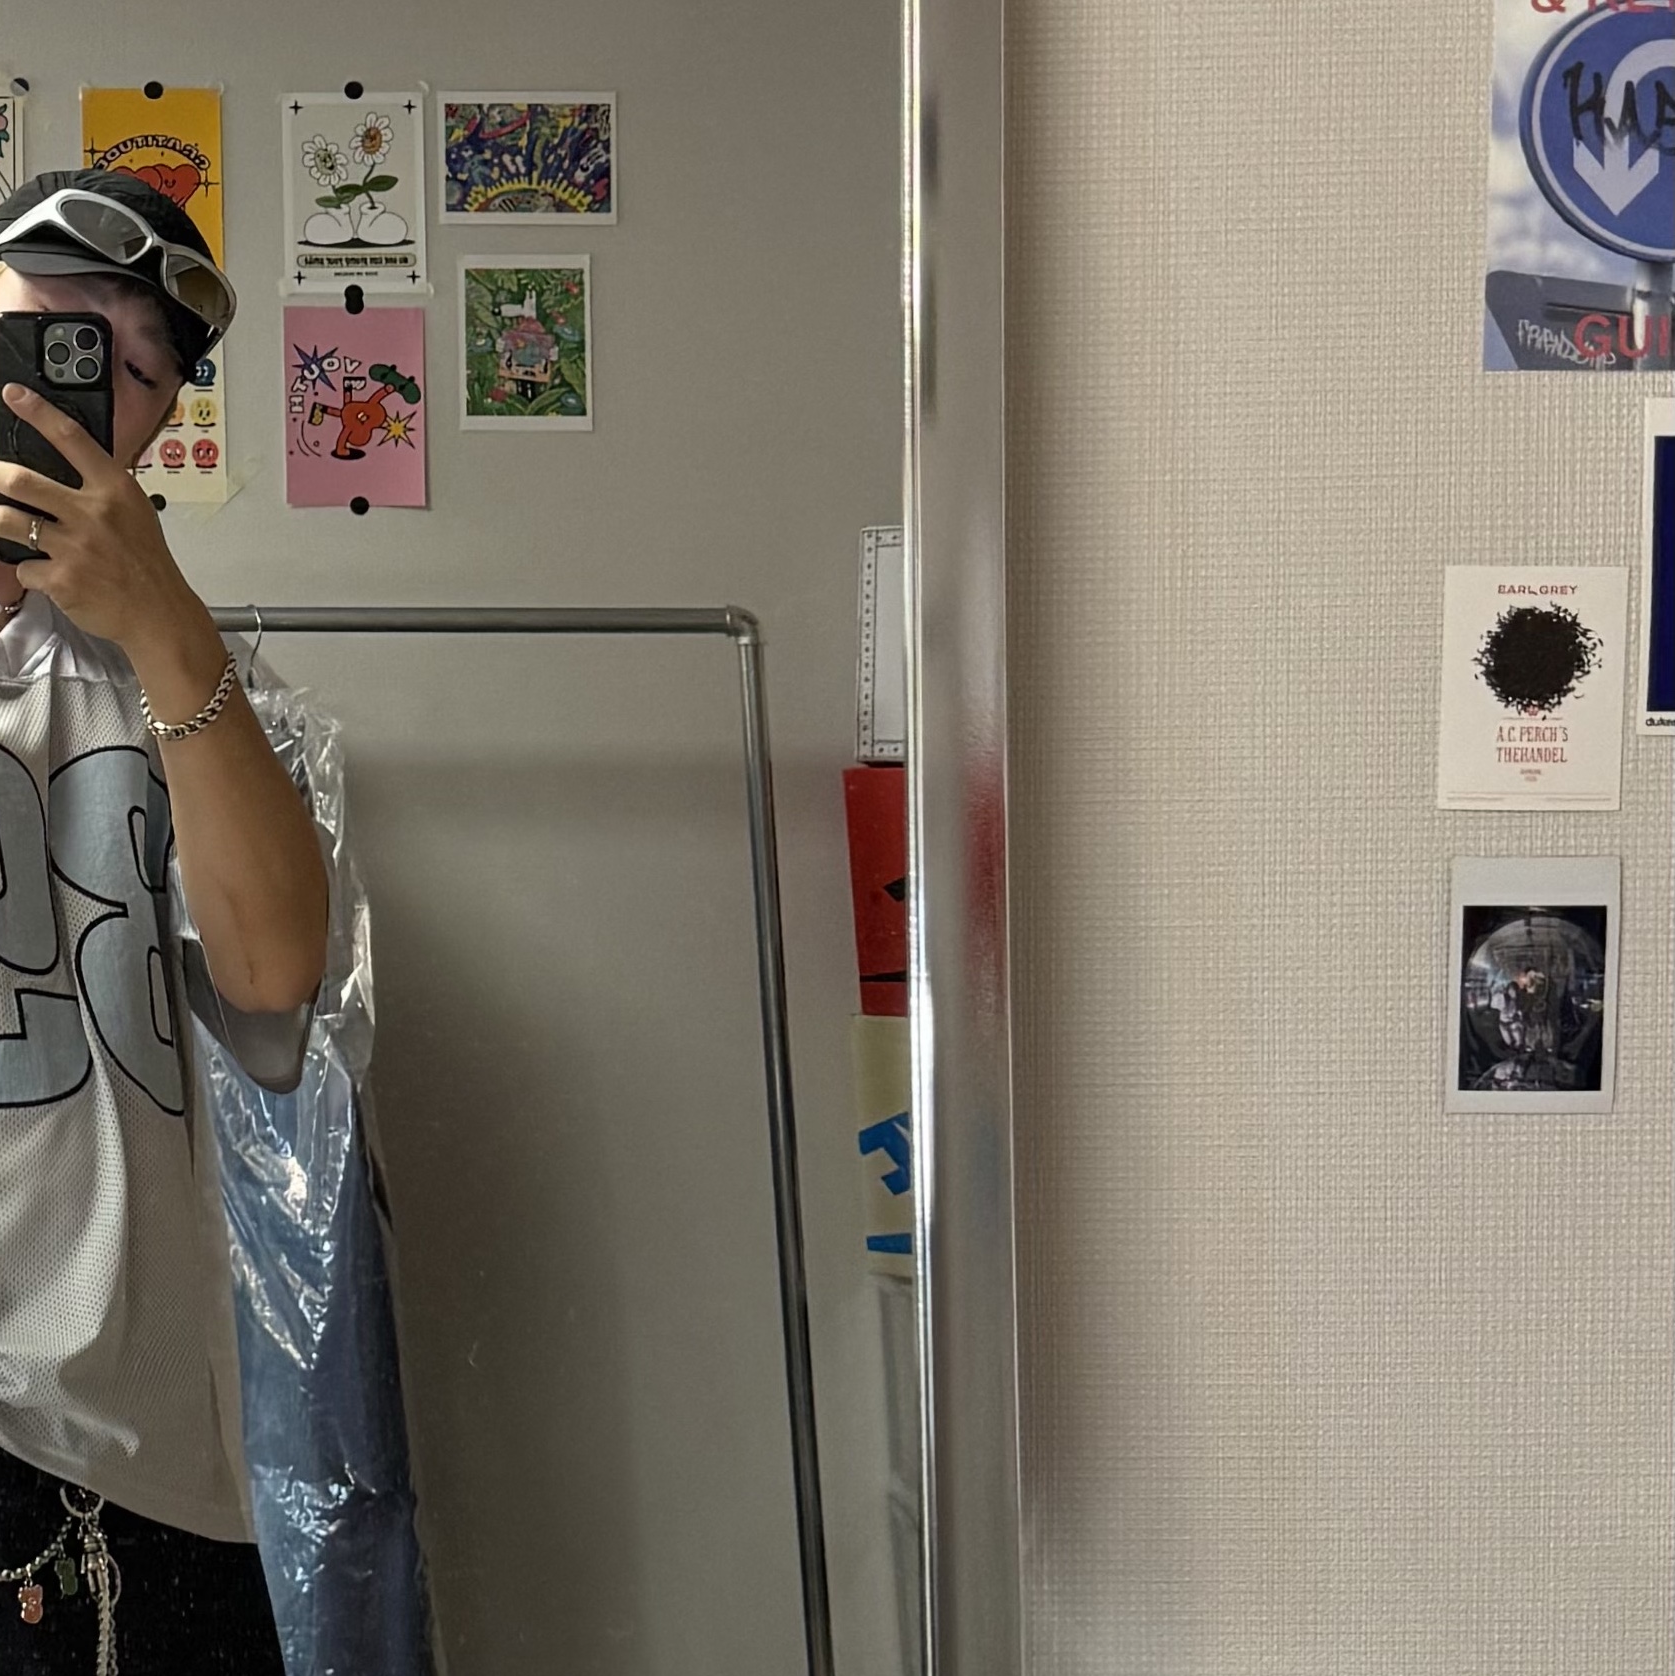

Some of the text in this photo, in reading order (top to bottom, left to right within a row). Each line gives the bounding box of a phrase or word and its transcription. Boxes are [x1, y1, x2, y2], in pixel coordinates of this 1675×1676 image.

[1498, 584, 1578, 596] EARL GREY
[1497, 747, 1568, 763] THEHANDEL
